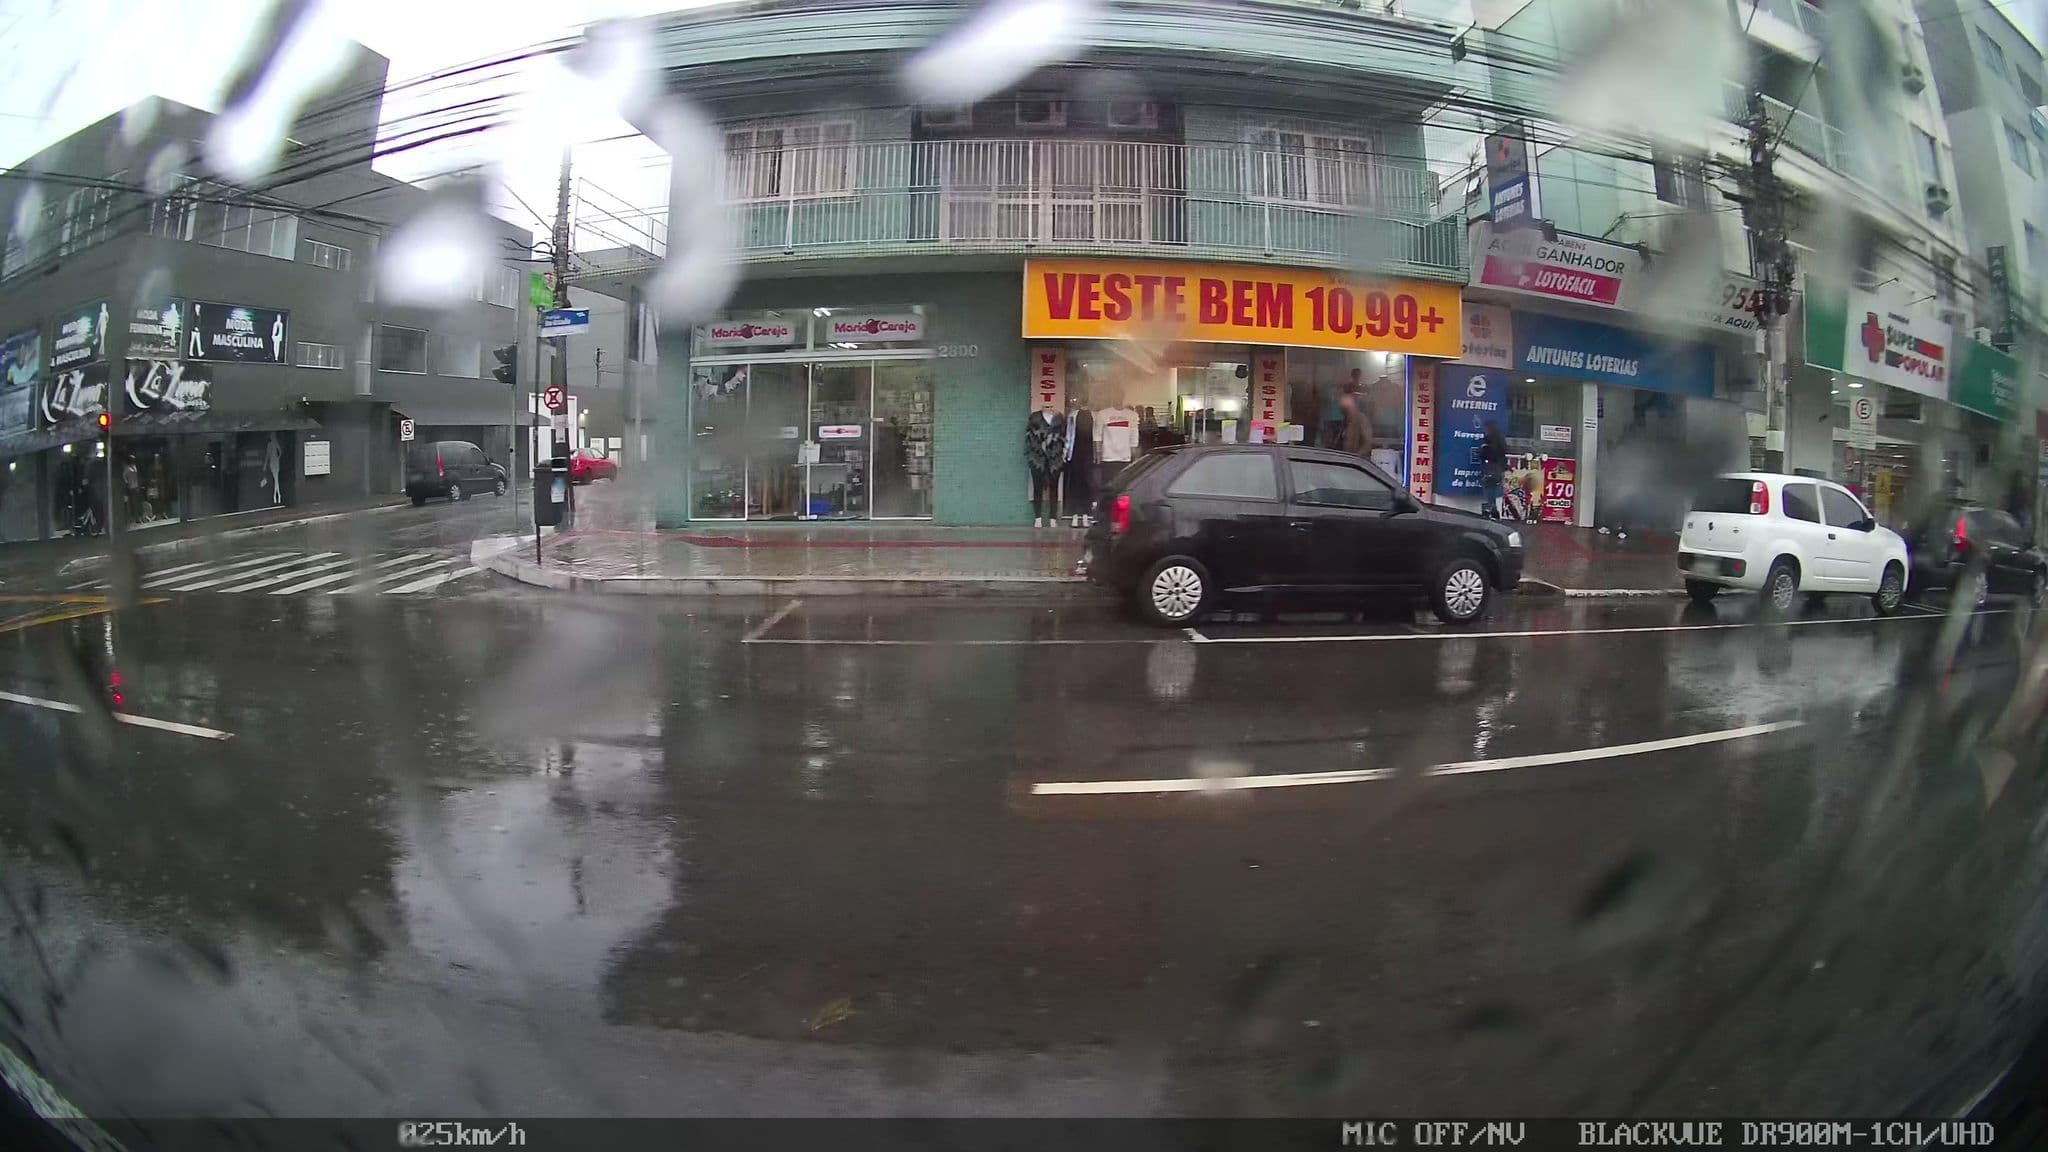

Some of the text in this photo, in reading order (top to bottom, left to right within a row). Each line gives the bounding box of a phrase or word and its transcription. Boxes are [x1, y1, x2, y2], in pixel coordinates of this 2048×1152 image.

[1536, 246, 1625, 275] GANHADOR
[1043, 272, 1445, 341] VESTE BEM 10,99+
[225, 318, 254, 333] MODA
[752, 326, 788, 338] Cereja
[834, 320, 917, 334] Maria Cereja
[211, 333, 264, 350] MASCULINA
[1526, 345, 1640, 378] ANTUNES LOTERIAS
[1451, 398, 1498, 412] INTERNET
[1545, 482, 1575, 498] 170
